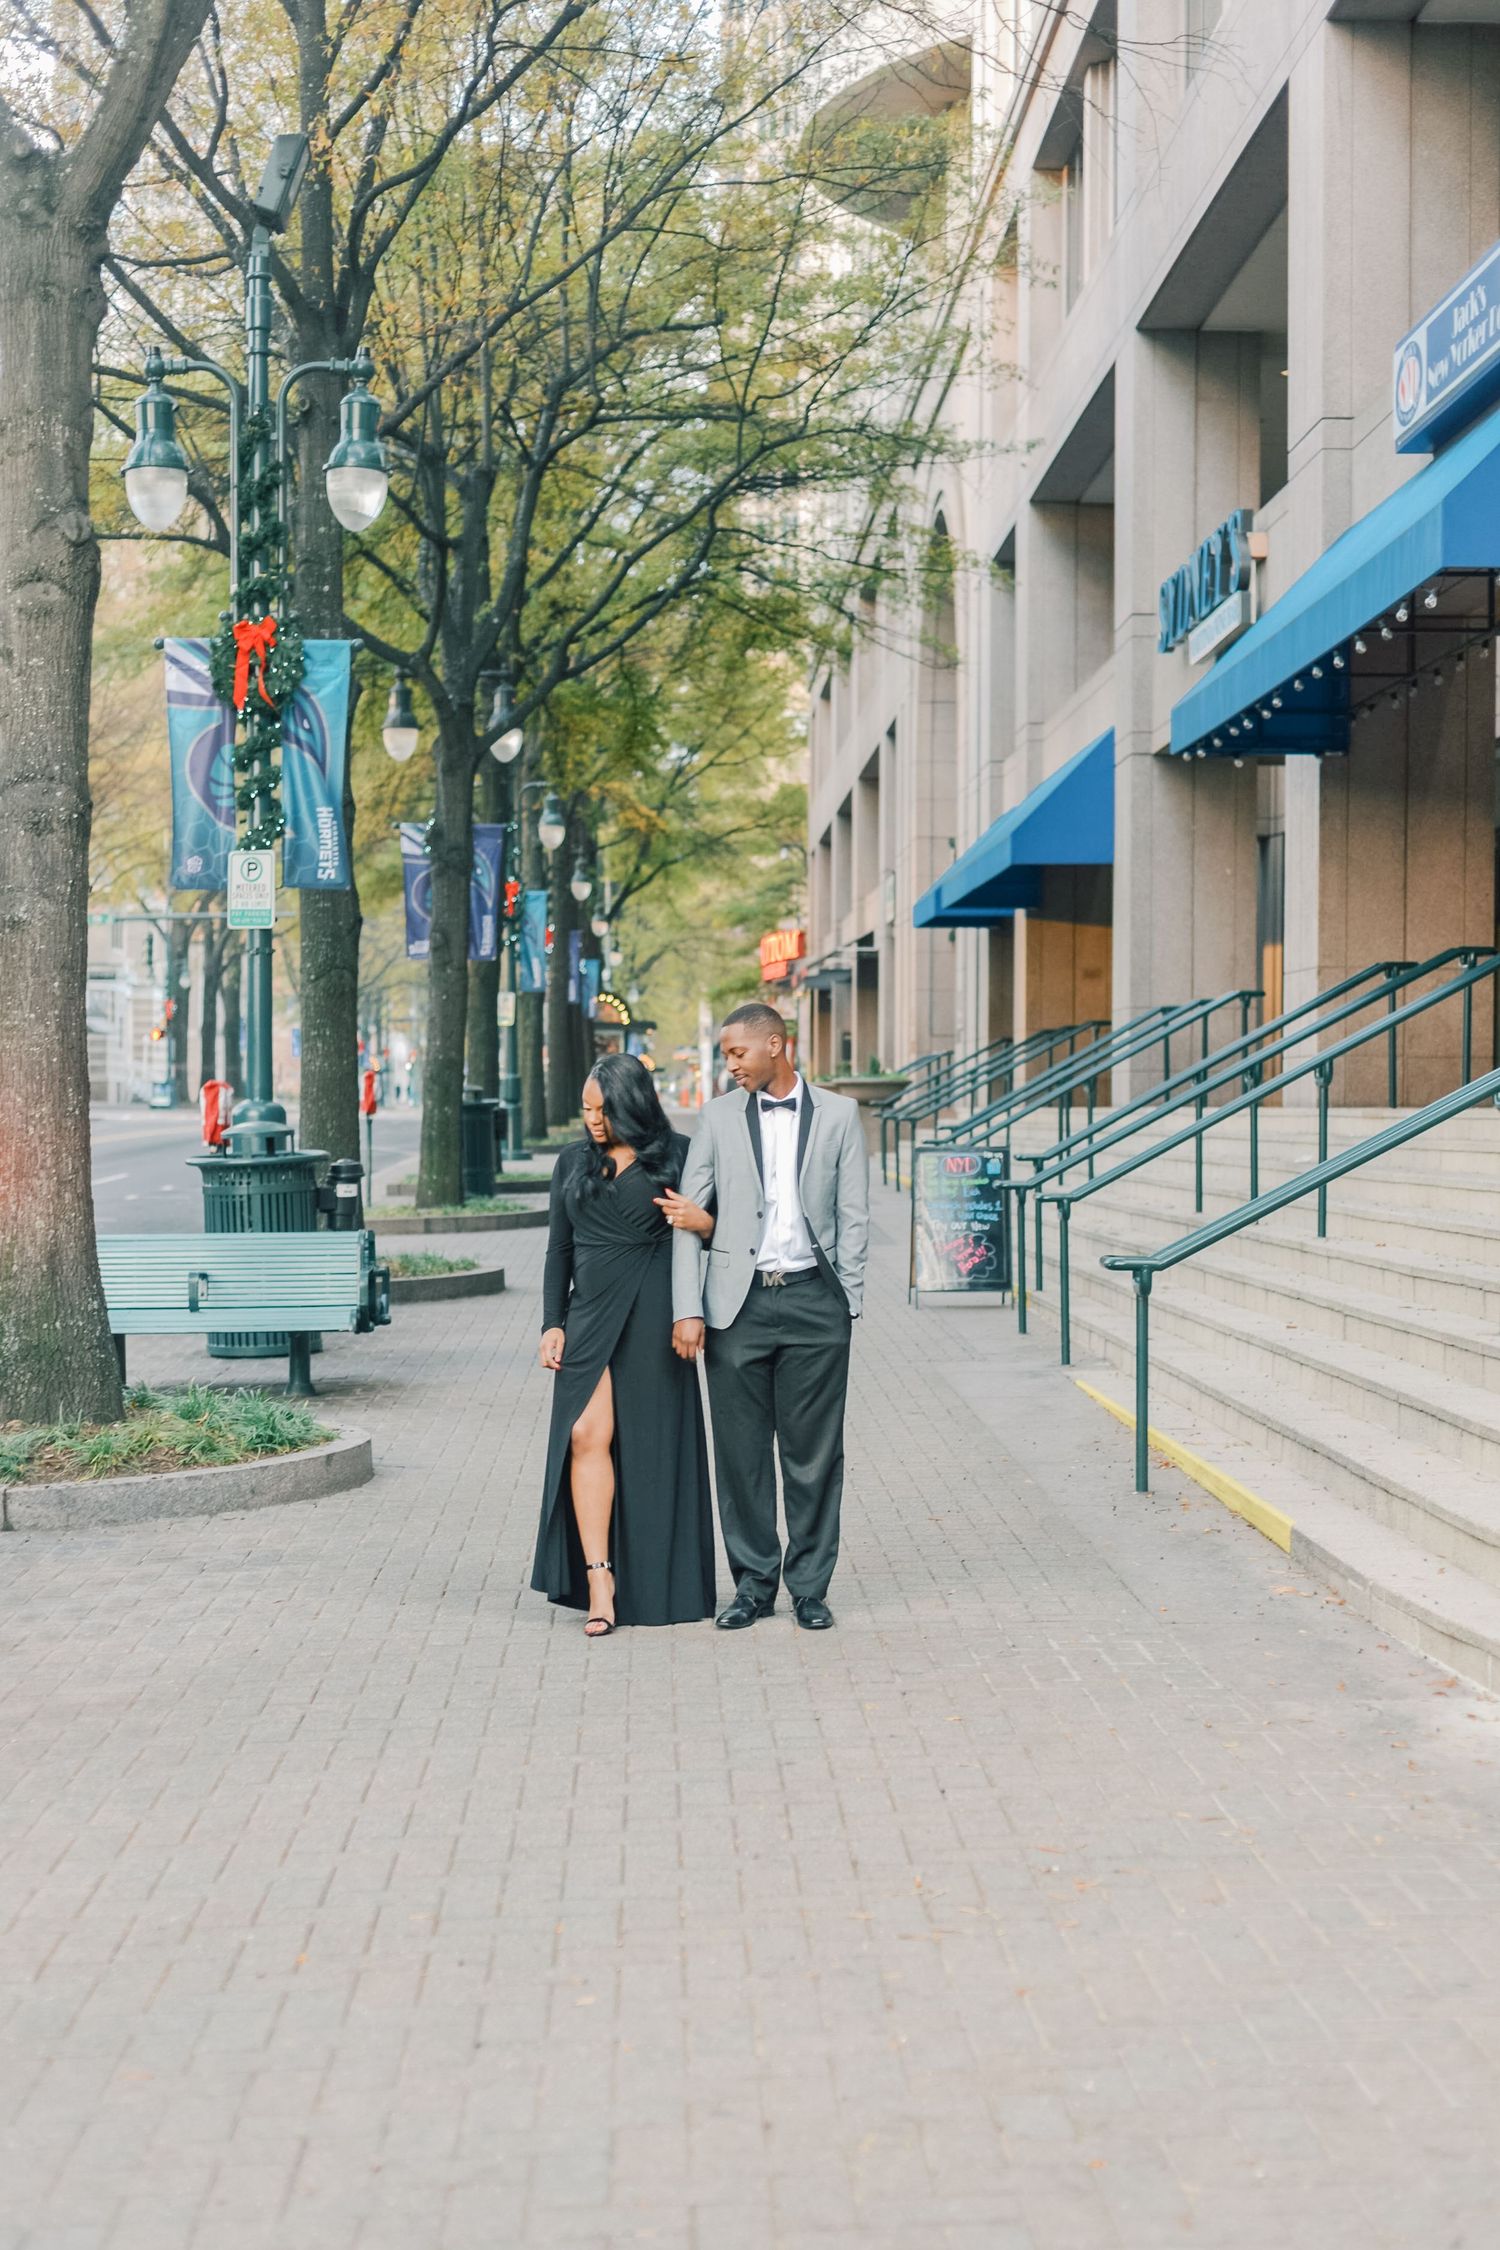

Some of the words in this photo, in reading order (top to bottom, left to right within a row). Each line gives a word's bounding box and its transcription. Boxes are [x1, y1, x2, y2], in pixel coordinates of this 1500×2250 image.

[1452, 284, 1487, 339] Jack's
[1428, 356, 1449, 389] New
[1450, 318, 1488, 367] Yorker
[247, 862, 258, 877] P
[316, 807, 336, 880] HORNETS
[763, 1271, 787, 1287] MK
